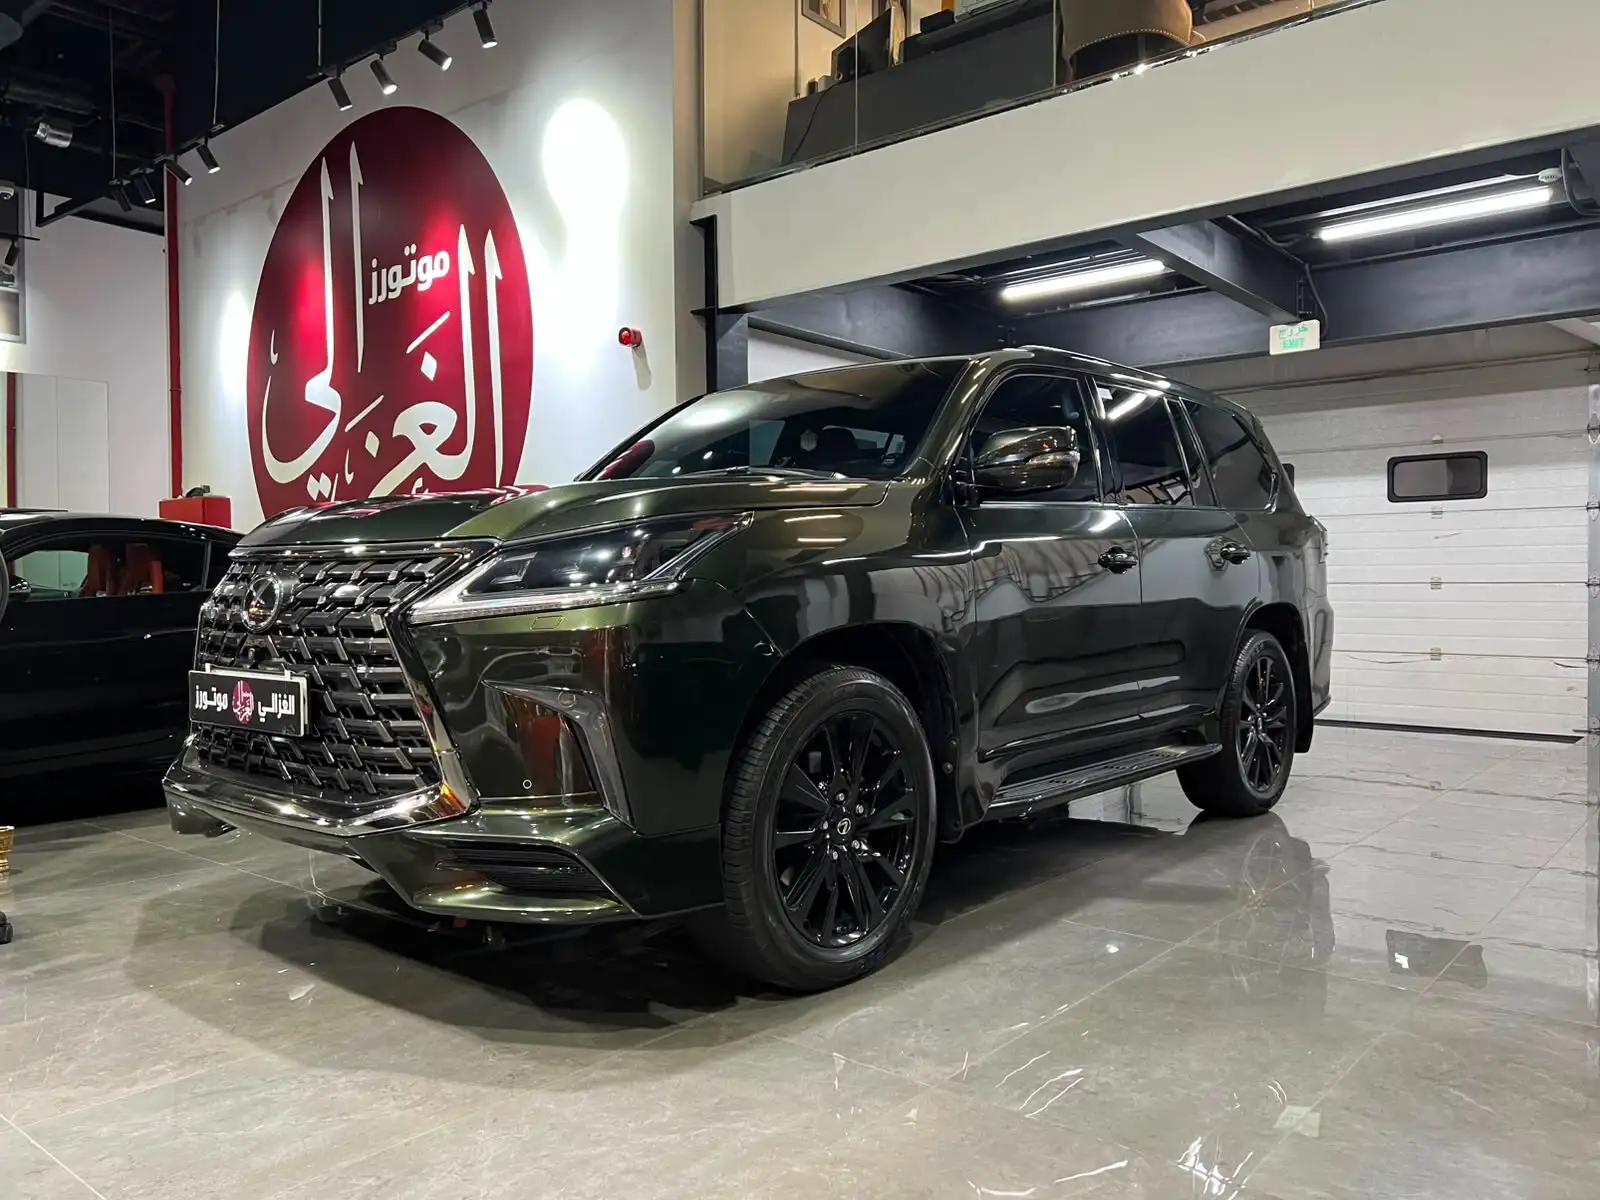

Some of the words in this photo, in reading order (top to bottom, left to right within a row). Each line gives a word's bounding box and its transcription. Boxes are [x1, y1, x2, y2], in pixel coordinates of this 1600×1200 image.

[368, 244, 450, 304] موتورز
[1282, 338, 1305, 349] EXIT
[195, 685, 228, 712] موتورز
[258, 693, 295, 722] الغزالي
